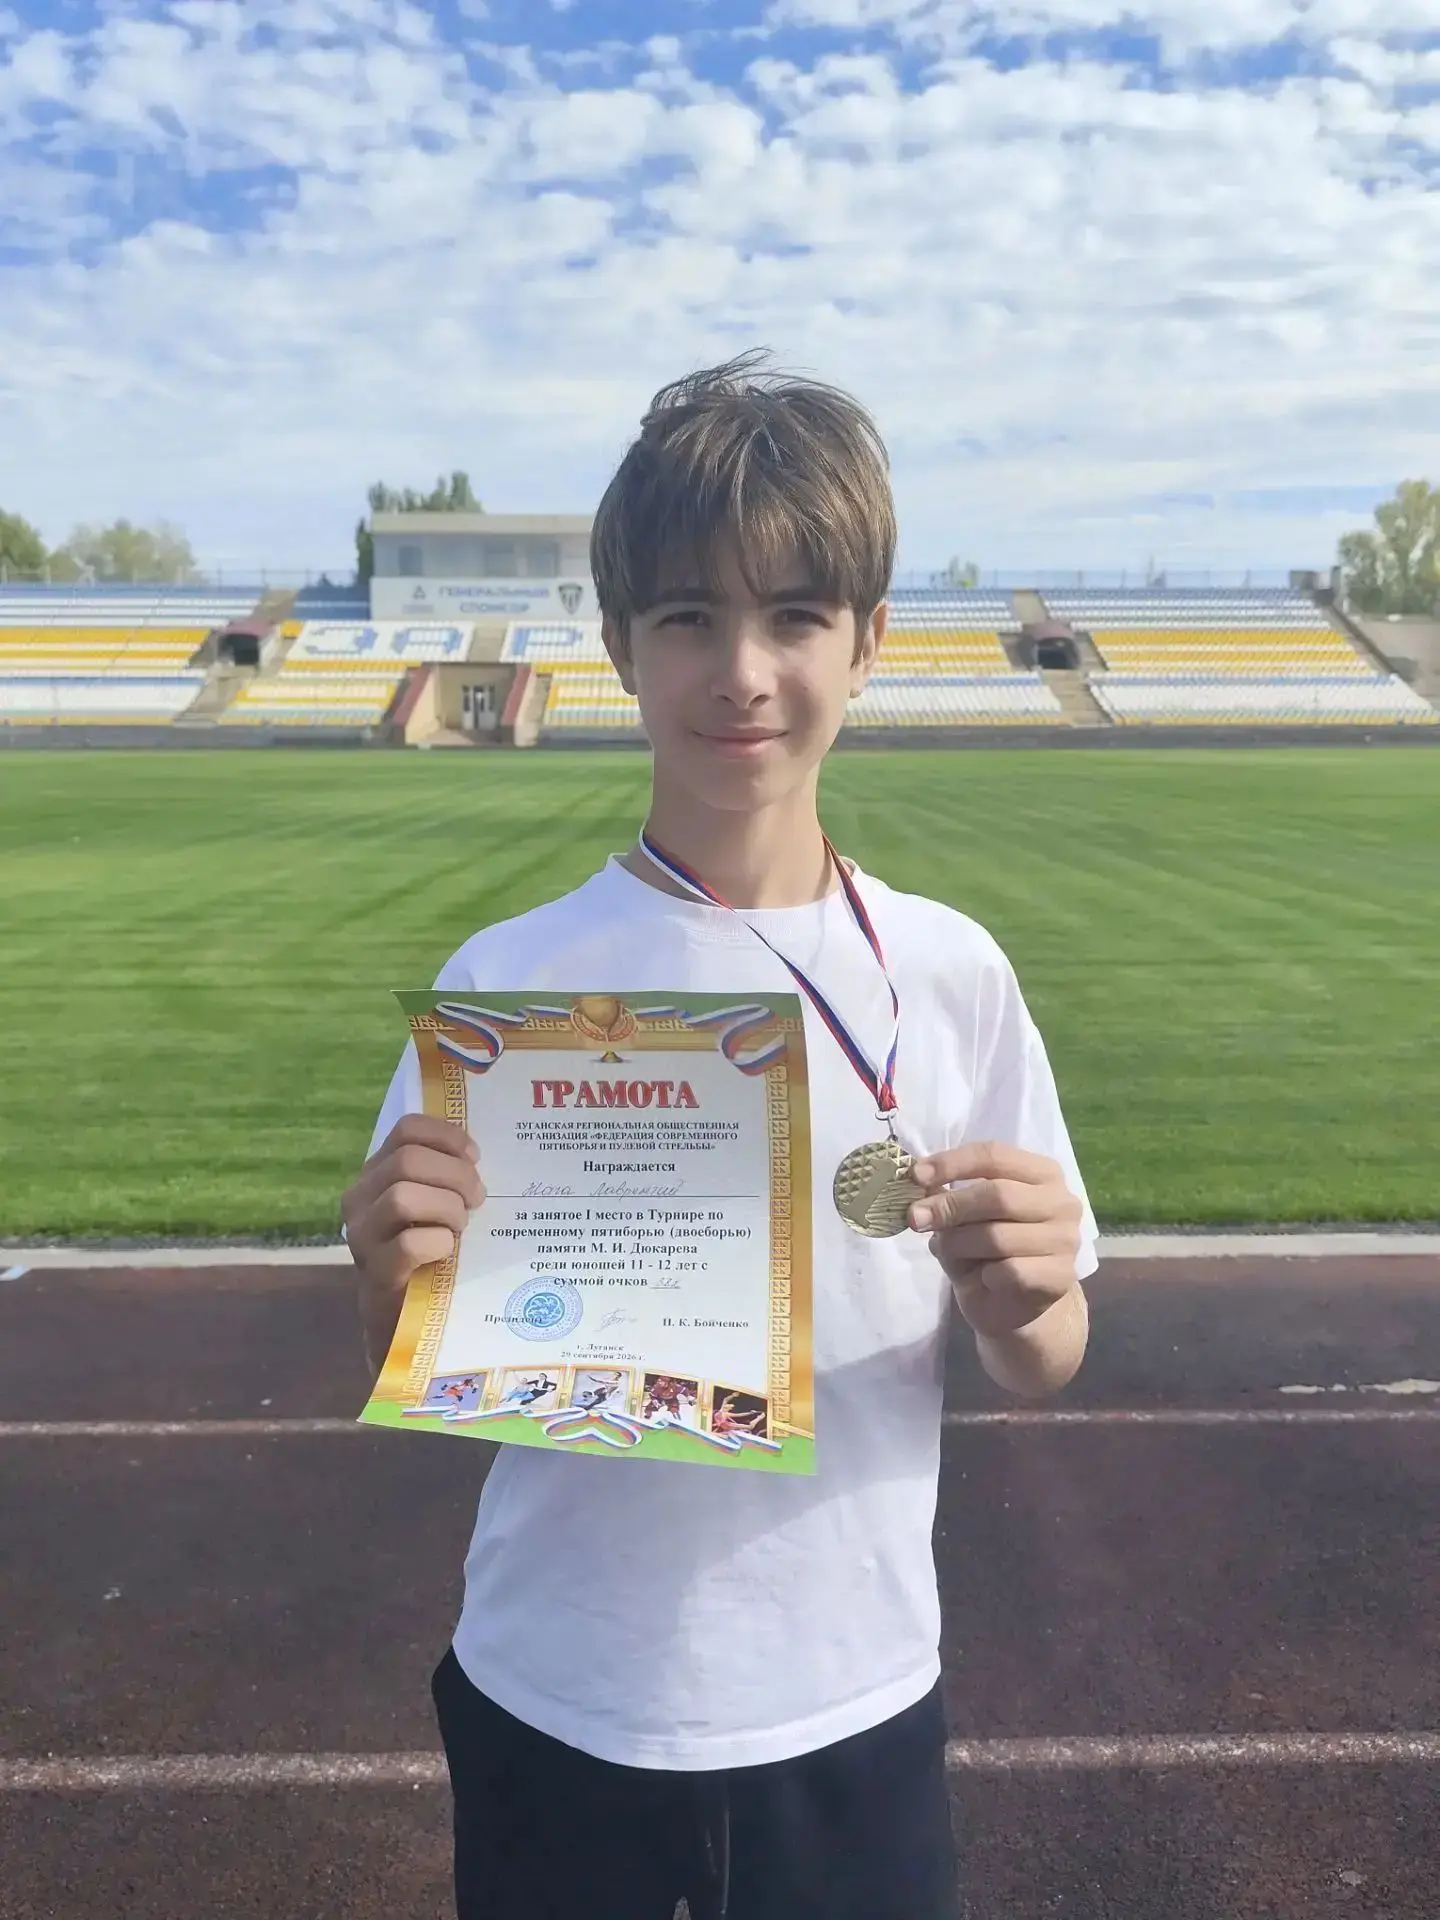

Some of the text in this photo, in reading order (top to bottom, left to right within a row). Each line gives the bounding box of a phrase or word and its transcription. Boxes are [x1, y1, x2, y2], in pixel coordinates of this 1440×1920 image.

[531, 1079, 700, 1109] ГРАМОТА
[515, 1121, 740, 1131] ЛУГАНСКАЯ РЕГИОНАЛЬНАЯ ОБЩЕСТВЕННАЯ
[516, 1131, 738, 1141] ОРГАНИЗАЦИЯ «ФЕДЕРАЦИЯ СОВРЕМЕННОГО
[539, 1140, 717, 1151] ПЯТИБОРЬЯ И ПУЛЕВОЙ СТРЕЛЬБЫ»
[583, 1161, 676, 1174] Награждается
[514, 1211, 528, 1221] за
[532, 1211, 582, 1221] занятое
[595, 1211, 633, 1221] место
[636, 1212, 643, 1221] в
[648, 1208, 704, 1224] Турнире
[708, 1212, 724, 1221] по
[490, 1226, 752, 1240] современному пятиборью (двоеборью)
[537, 1242, 698, 1257] памяти М. И. Дюкарева
[530, 1259, 567, 1272] среди
[571, 1257, 625, 1270] юношей
[630, 1259, 644, 1270] 11
[658, 1259, 672, 1270] 12
[675, 1261, 701, 1272] лет
[701, 1262, 708, 1271] с
[553, 1275, 648, 1288] суммой очков
[679, 1318, 691, 1328] К.
[694, 1318, 749, 1328] Бойченко
[573, 1351, 614, 1361] сентября
